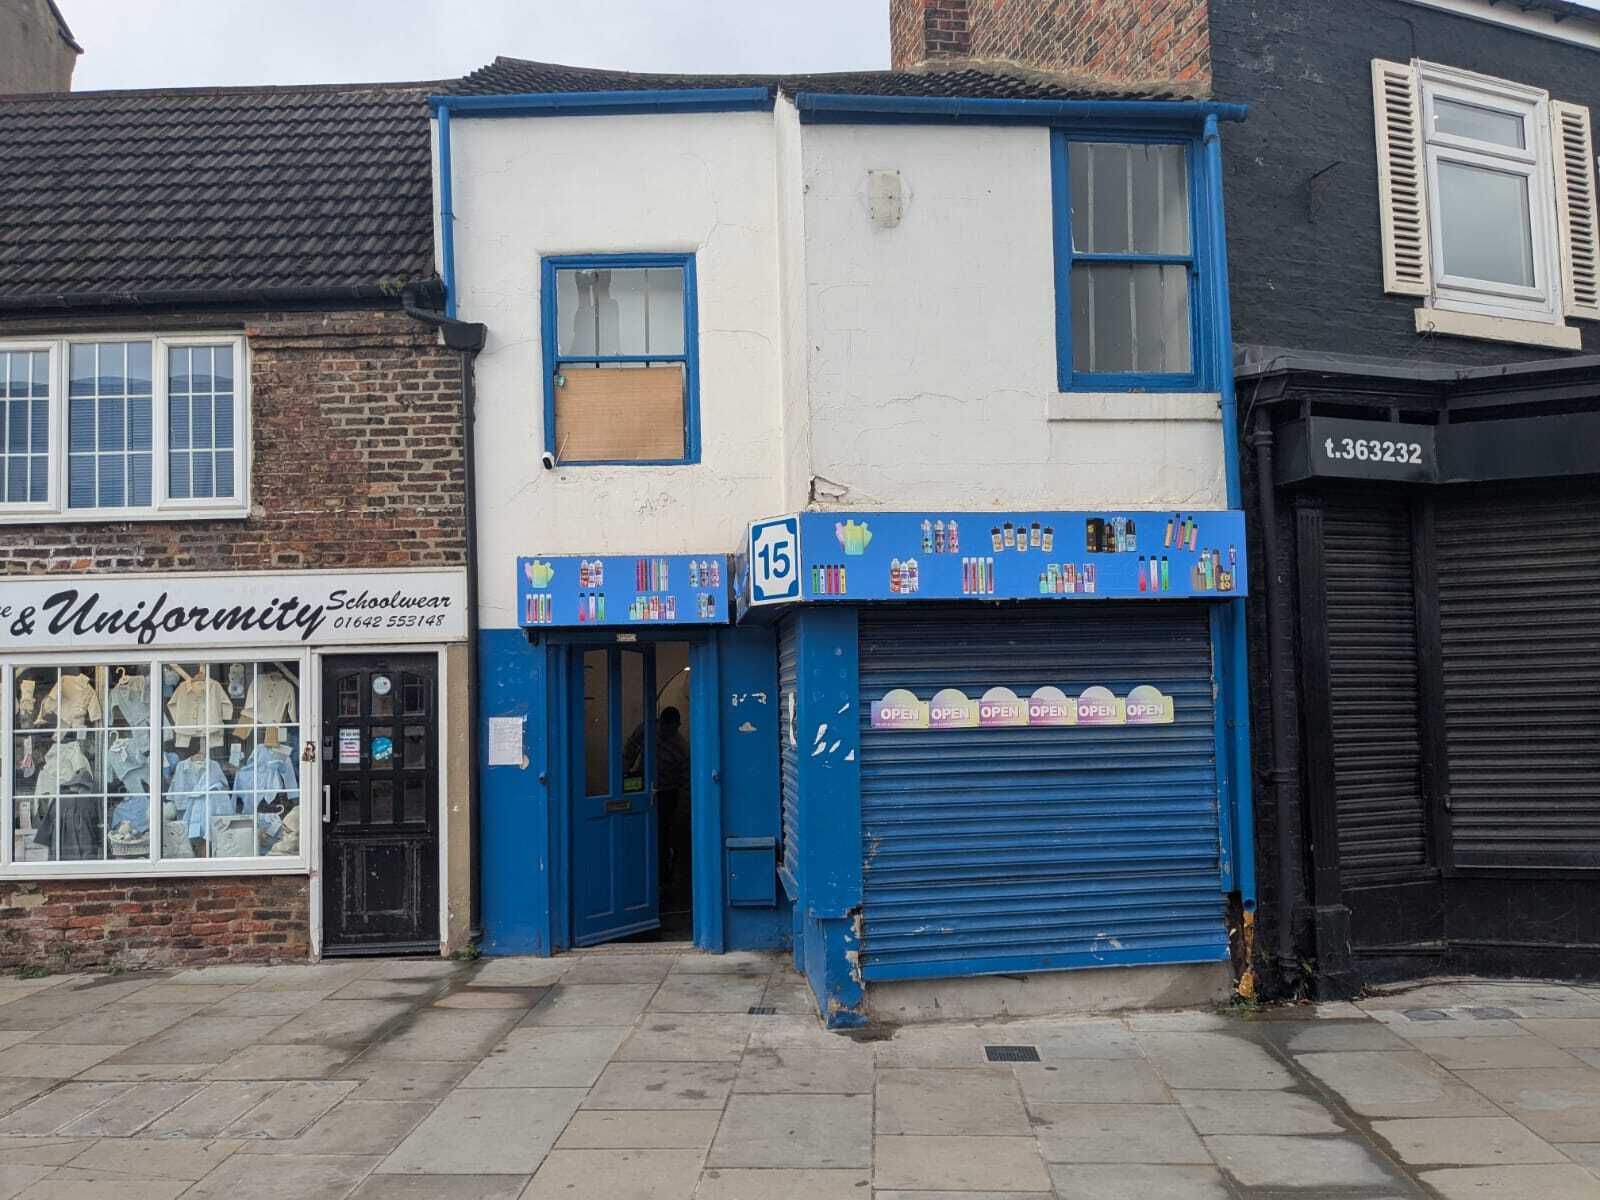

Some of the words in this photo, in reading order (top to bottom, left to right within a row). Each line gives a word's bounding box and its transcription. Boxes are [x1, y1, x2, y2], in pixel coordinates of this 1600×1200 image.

[1324, 437, 1422, 465] t.363232
[758, 541, 791, 580] 15
[326, 589, 452, 611] Schoolwear
[10, 606, 36, 636] &
[42, 589, 326, 645] Uniformity
[333, 615, 383, 629] 01642
[386, 614, 445, 628] 553148
[880, 706, 919, 721] OPEN
[931, 706, 970, 721] OPEN
[980, 705, 1019, 719] OPEN
[1029, 704, 1068, 718] OPEN
[1078, 704, 1116, 717] OPEN
[1126, 702, 1164, 717] OPEN
